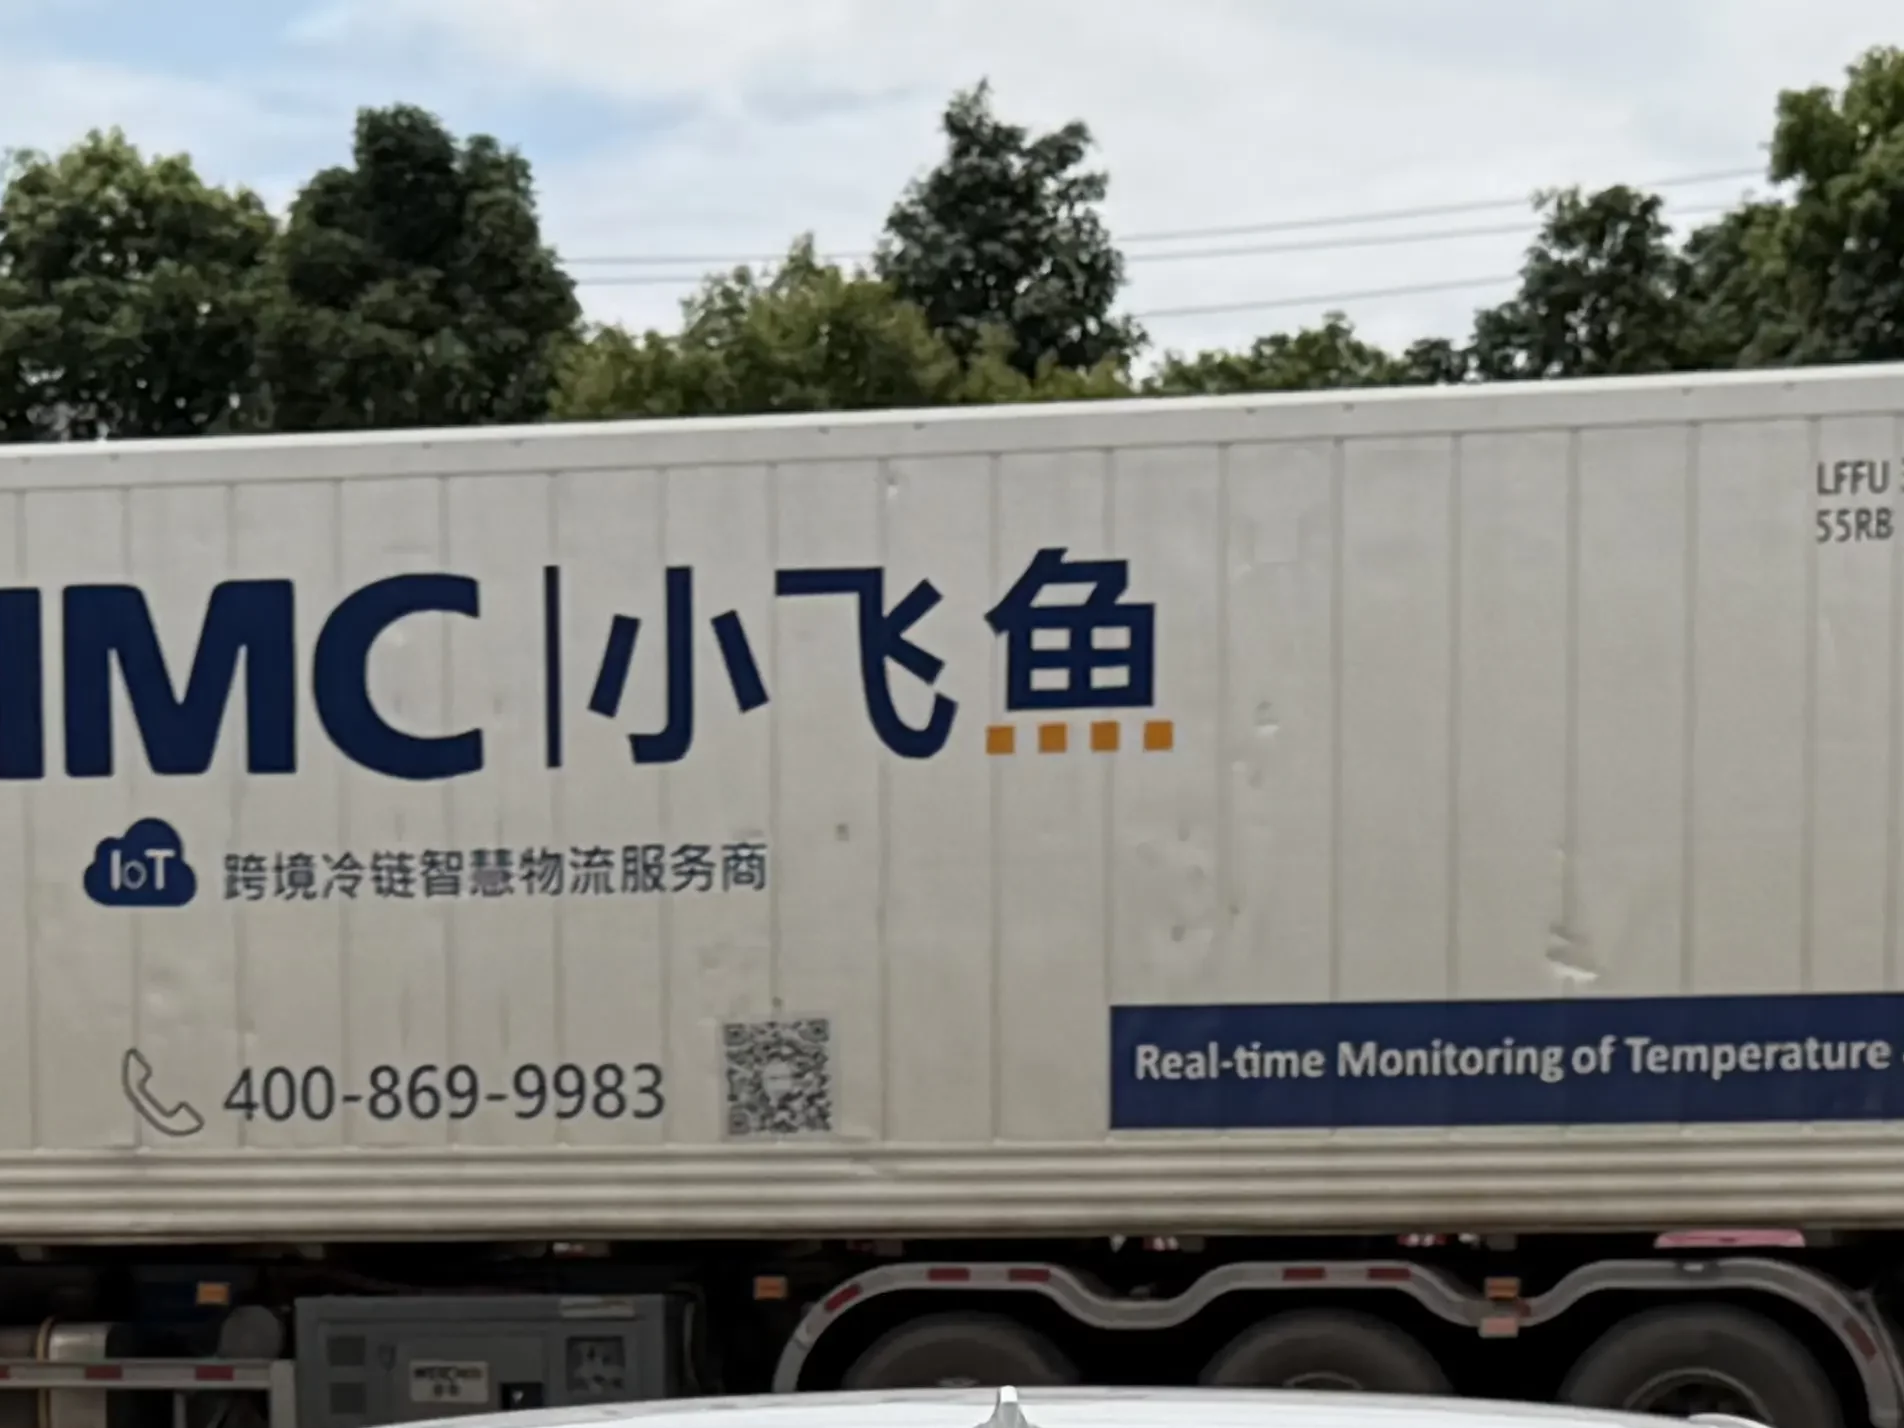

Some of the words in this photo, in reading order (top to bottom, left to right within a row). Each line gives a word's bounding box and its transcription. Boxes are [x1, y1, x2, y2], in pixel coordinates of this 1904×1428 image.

[1816, 459, 1890, 496] LFFU
[1816, 506, 1895, 544] 55RB
[587, 547, 1175, 764] 小飞鱼
[110, 847, 178, 891] IoT
[223, 841, 768, 901] 跨境冷链智慧物流服务商
[1134, 1041, 1326, 1081] Real-time
[1337, 1036, 1565, 1083] Monitoring
[1571, 1034, 1615, 1075] of
[1623, 1033, 1892, 1079] Temperature
[223, 1062, 667, 1122] 400-869-9983
